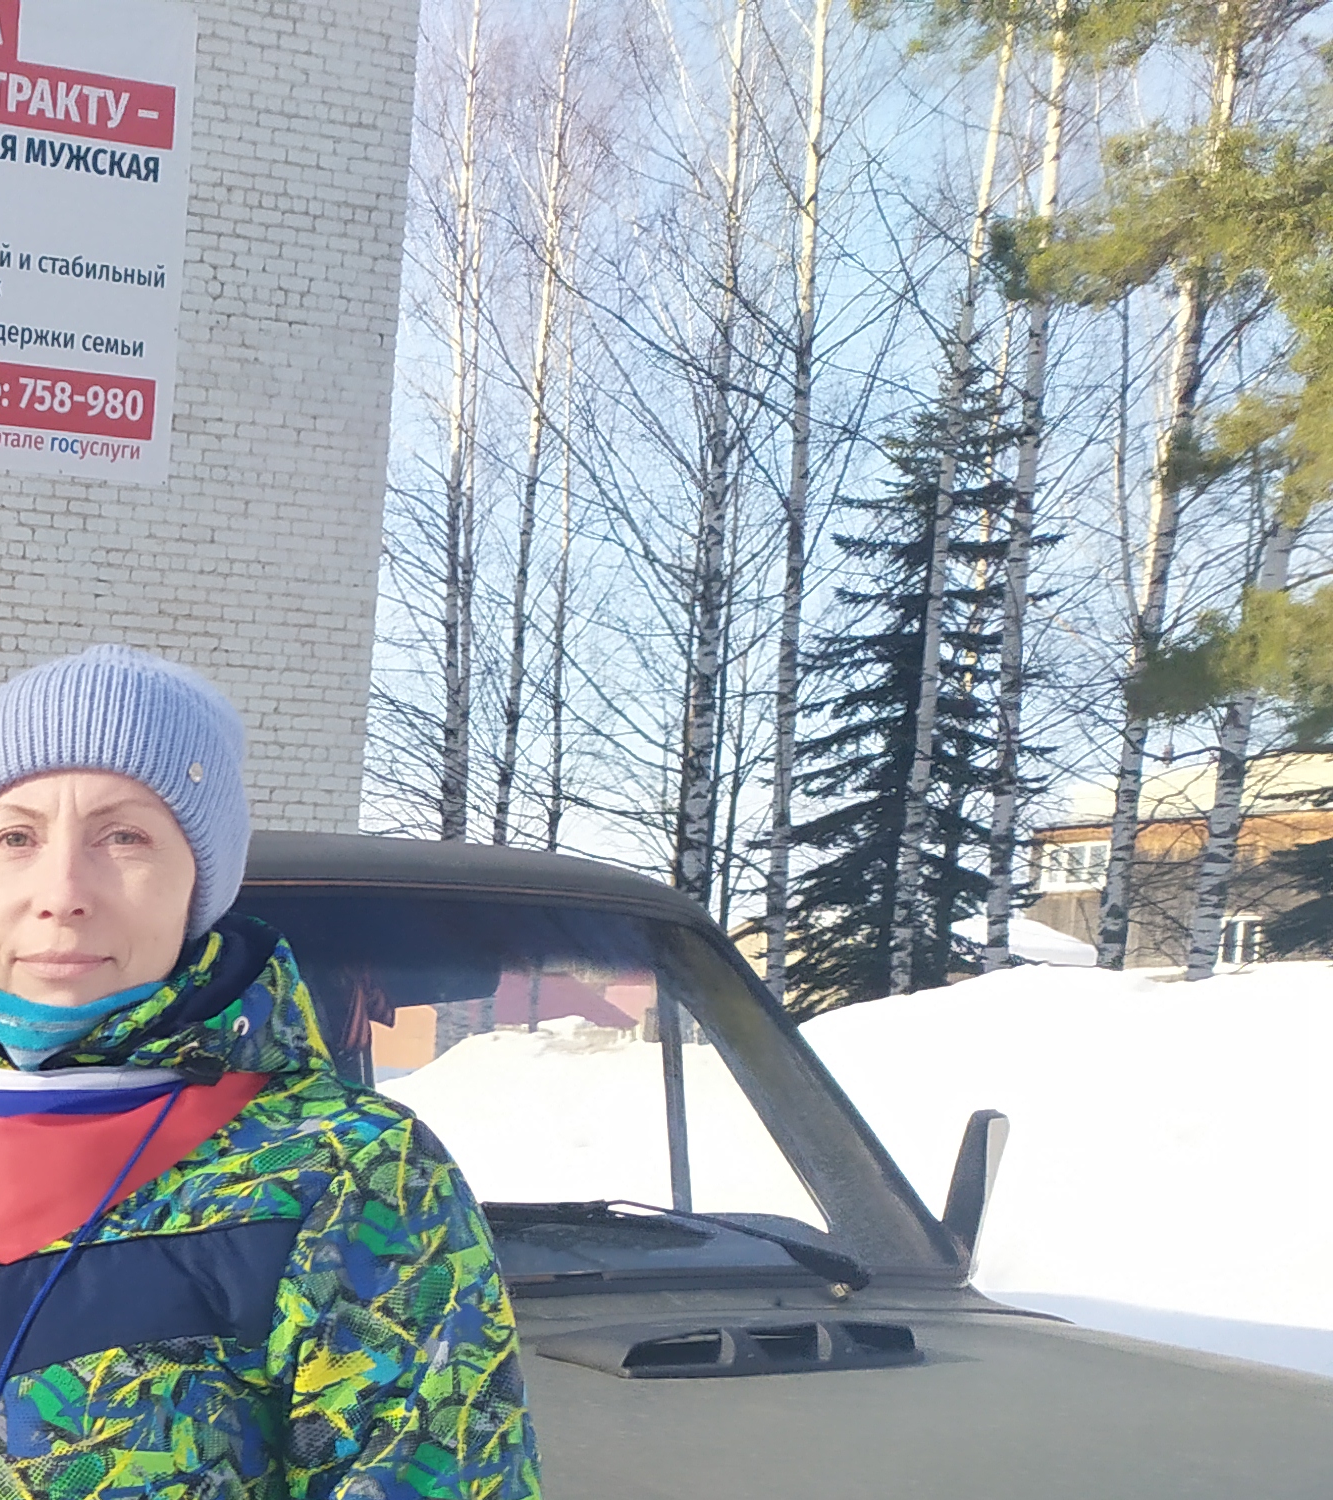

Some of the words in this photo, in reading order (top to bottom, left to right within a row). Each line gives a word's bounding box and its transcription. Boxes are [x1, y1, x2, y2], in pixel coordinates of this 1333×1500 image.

[25, 138, 161, 184] МУЖСКАЯ
[19, 252, 32, 271] и
[38, 254, 166, 289] стабильный
[82, 333, 145, 358] семьи
[19, 377, 144, 422] 758-980
[50, 436, 141, 460] госуслуги
